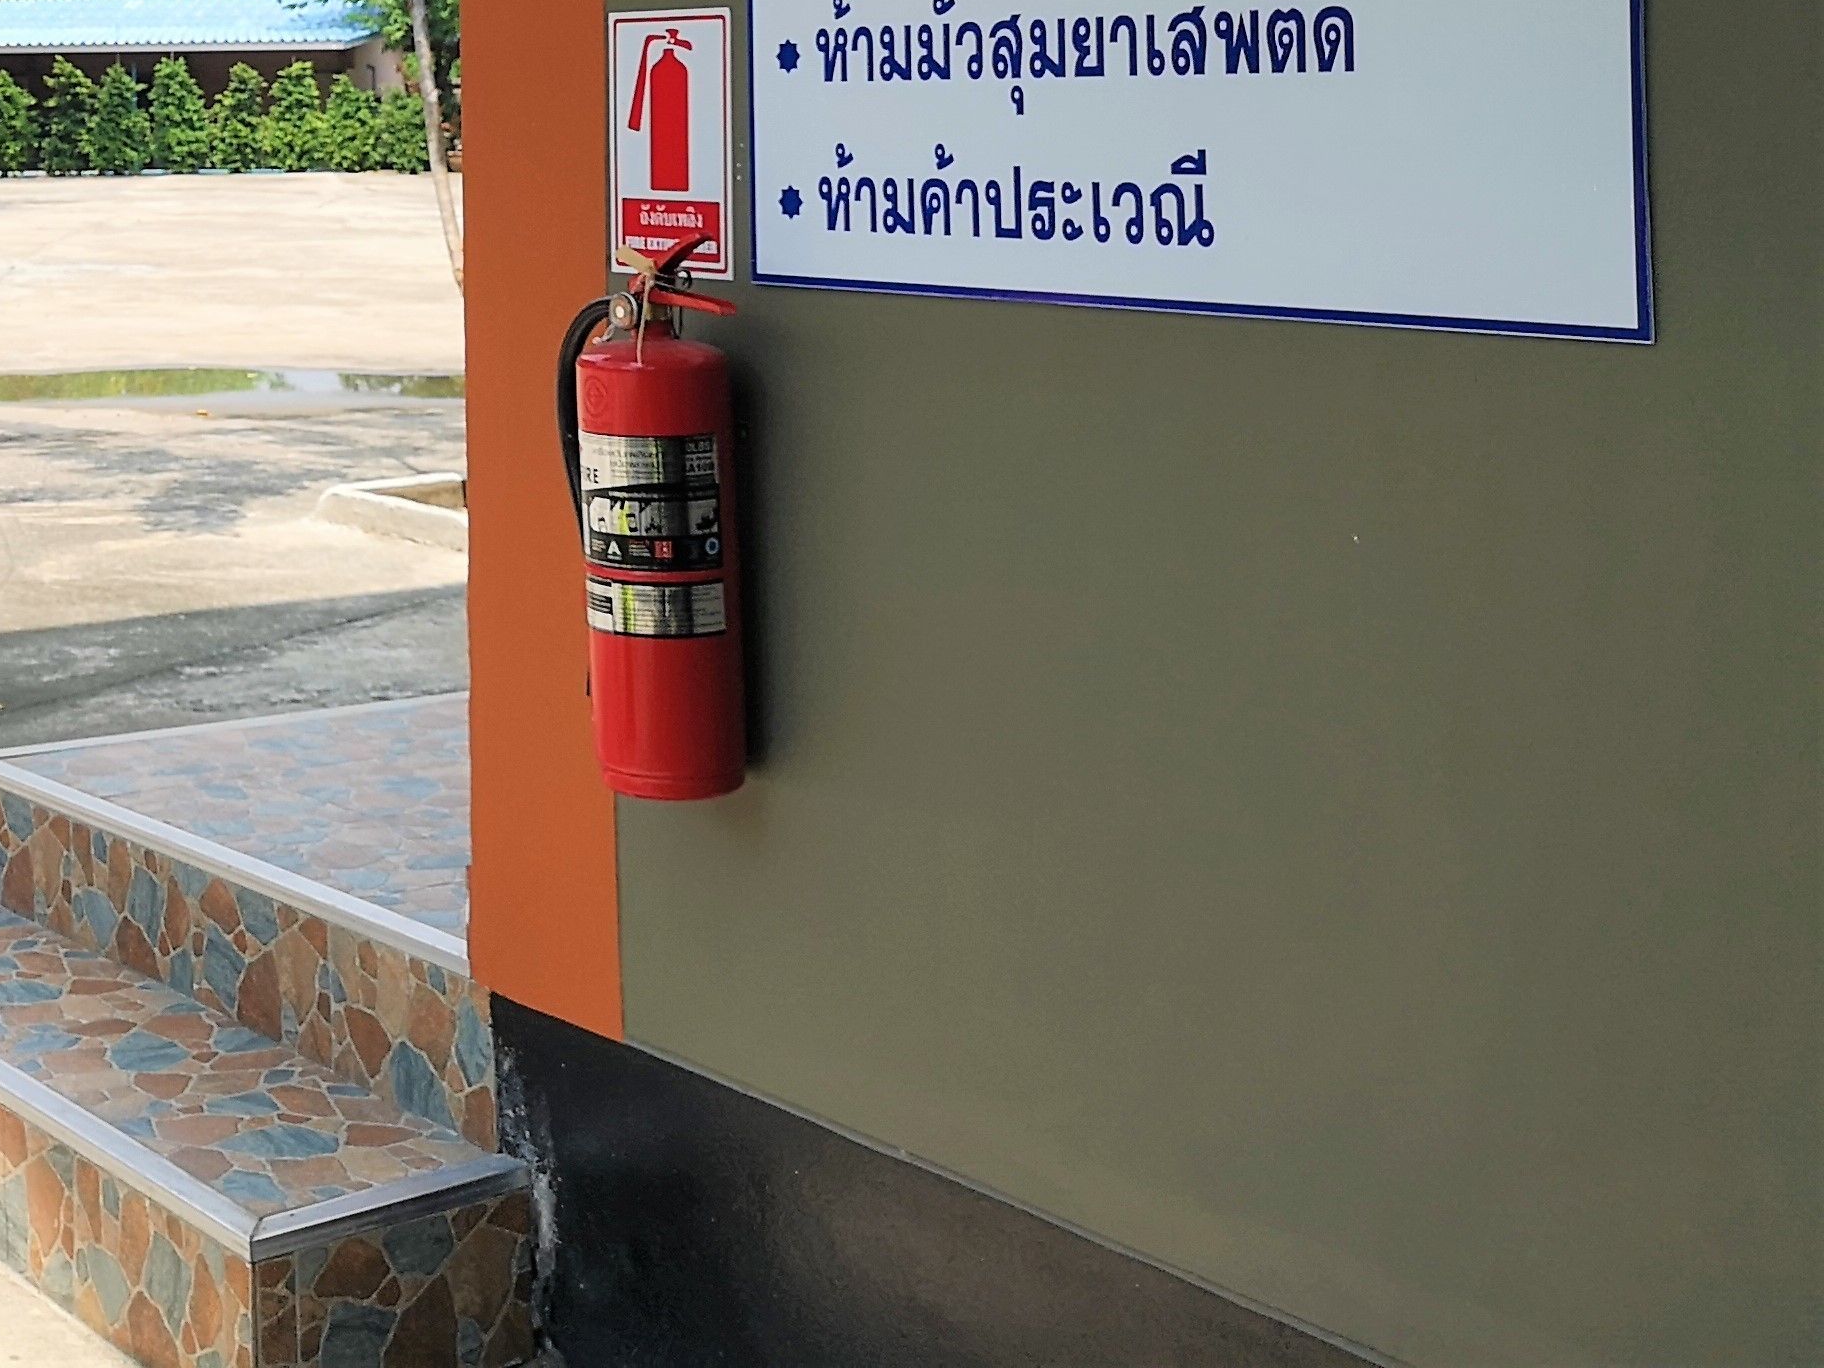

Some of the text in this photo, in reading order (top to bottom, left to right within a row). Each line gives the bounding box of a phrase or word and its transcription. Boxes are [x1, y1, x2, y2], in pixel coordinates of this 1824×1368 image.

[818, 143, 1215, 248] ห้ามค้าประเวณี
